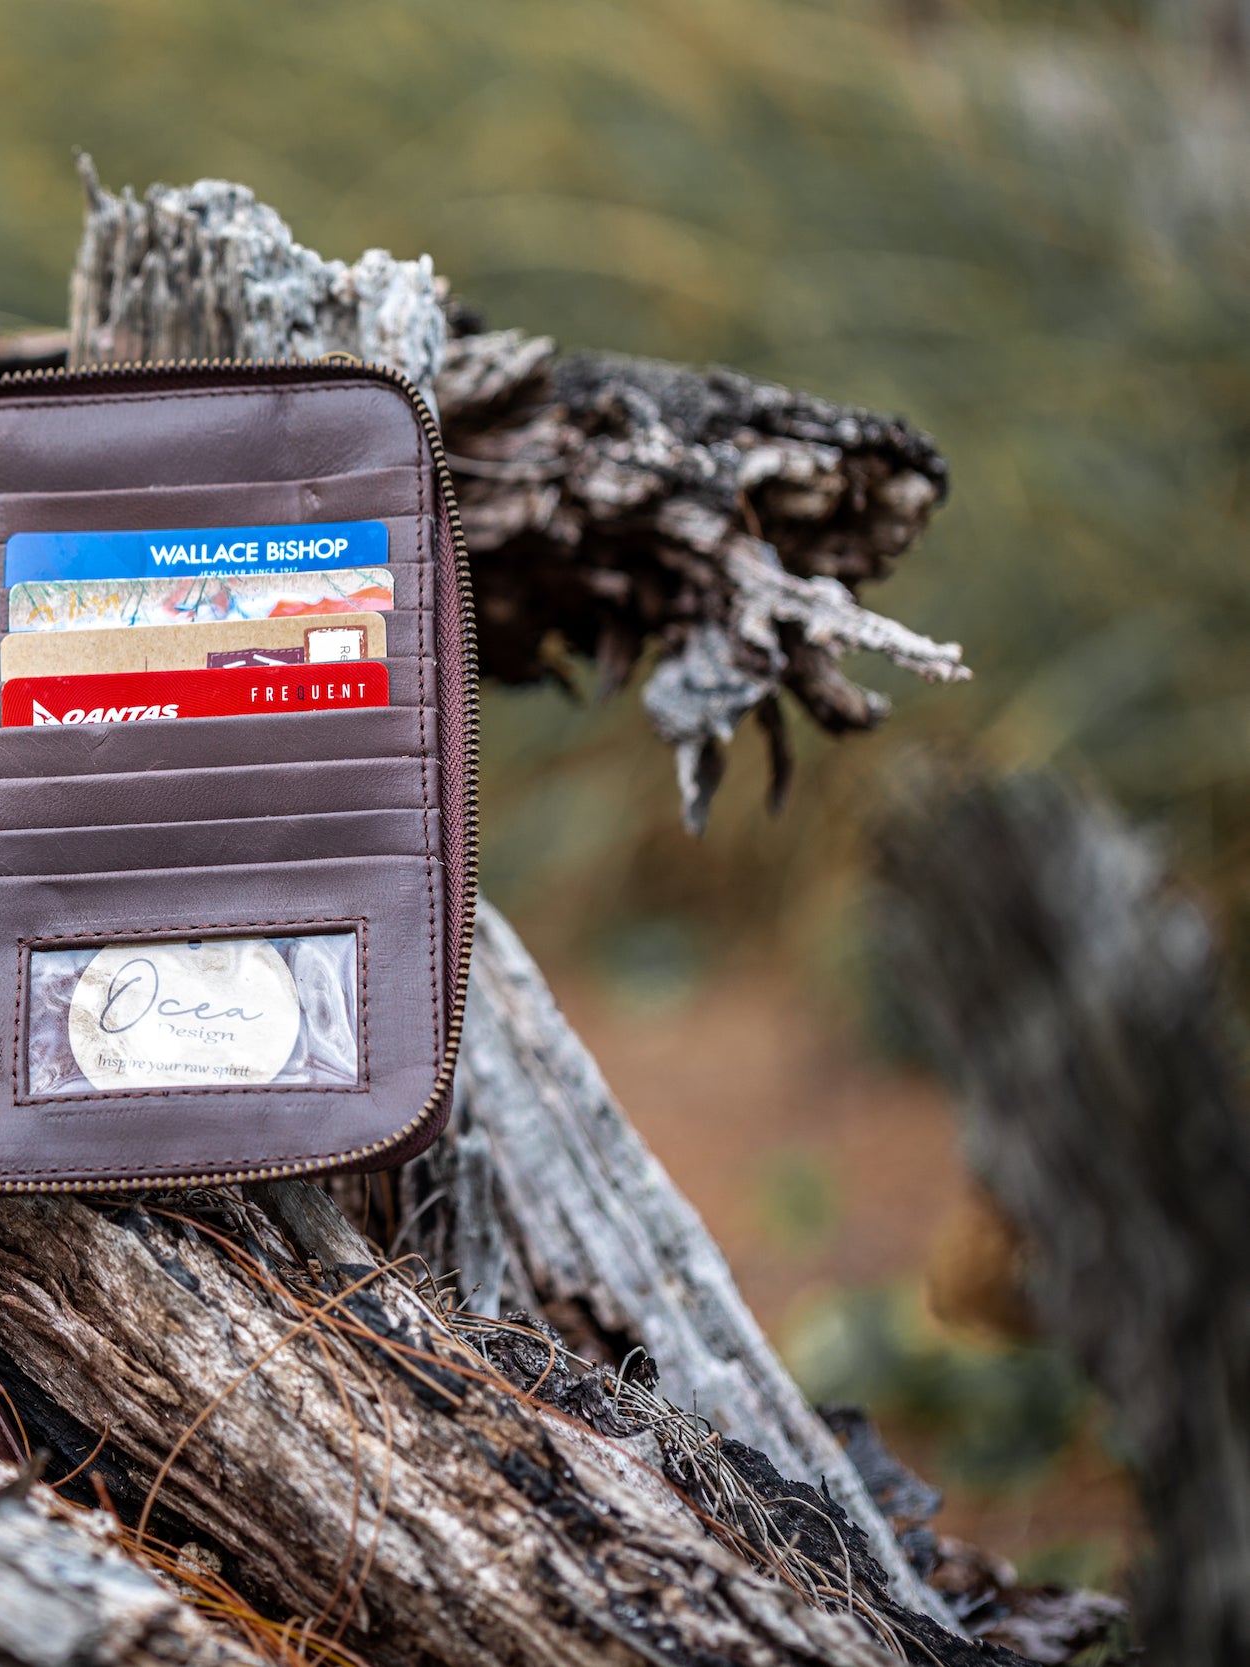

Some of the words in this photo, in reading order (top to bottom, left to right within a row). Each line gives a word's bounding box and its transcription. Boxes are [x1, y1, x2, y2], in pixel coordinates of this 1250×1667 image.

[150, 542, 259, 566] WALLACE
[251, 683, 366, 703] FREQUENT
[100, 958, 264, 1034] Ocea
[149, 1059, 182, 1073] your
[184, 1063, 210, 1073] raw
[212, 1063, 250, 1079] spirit
